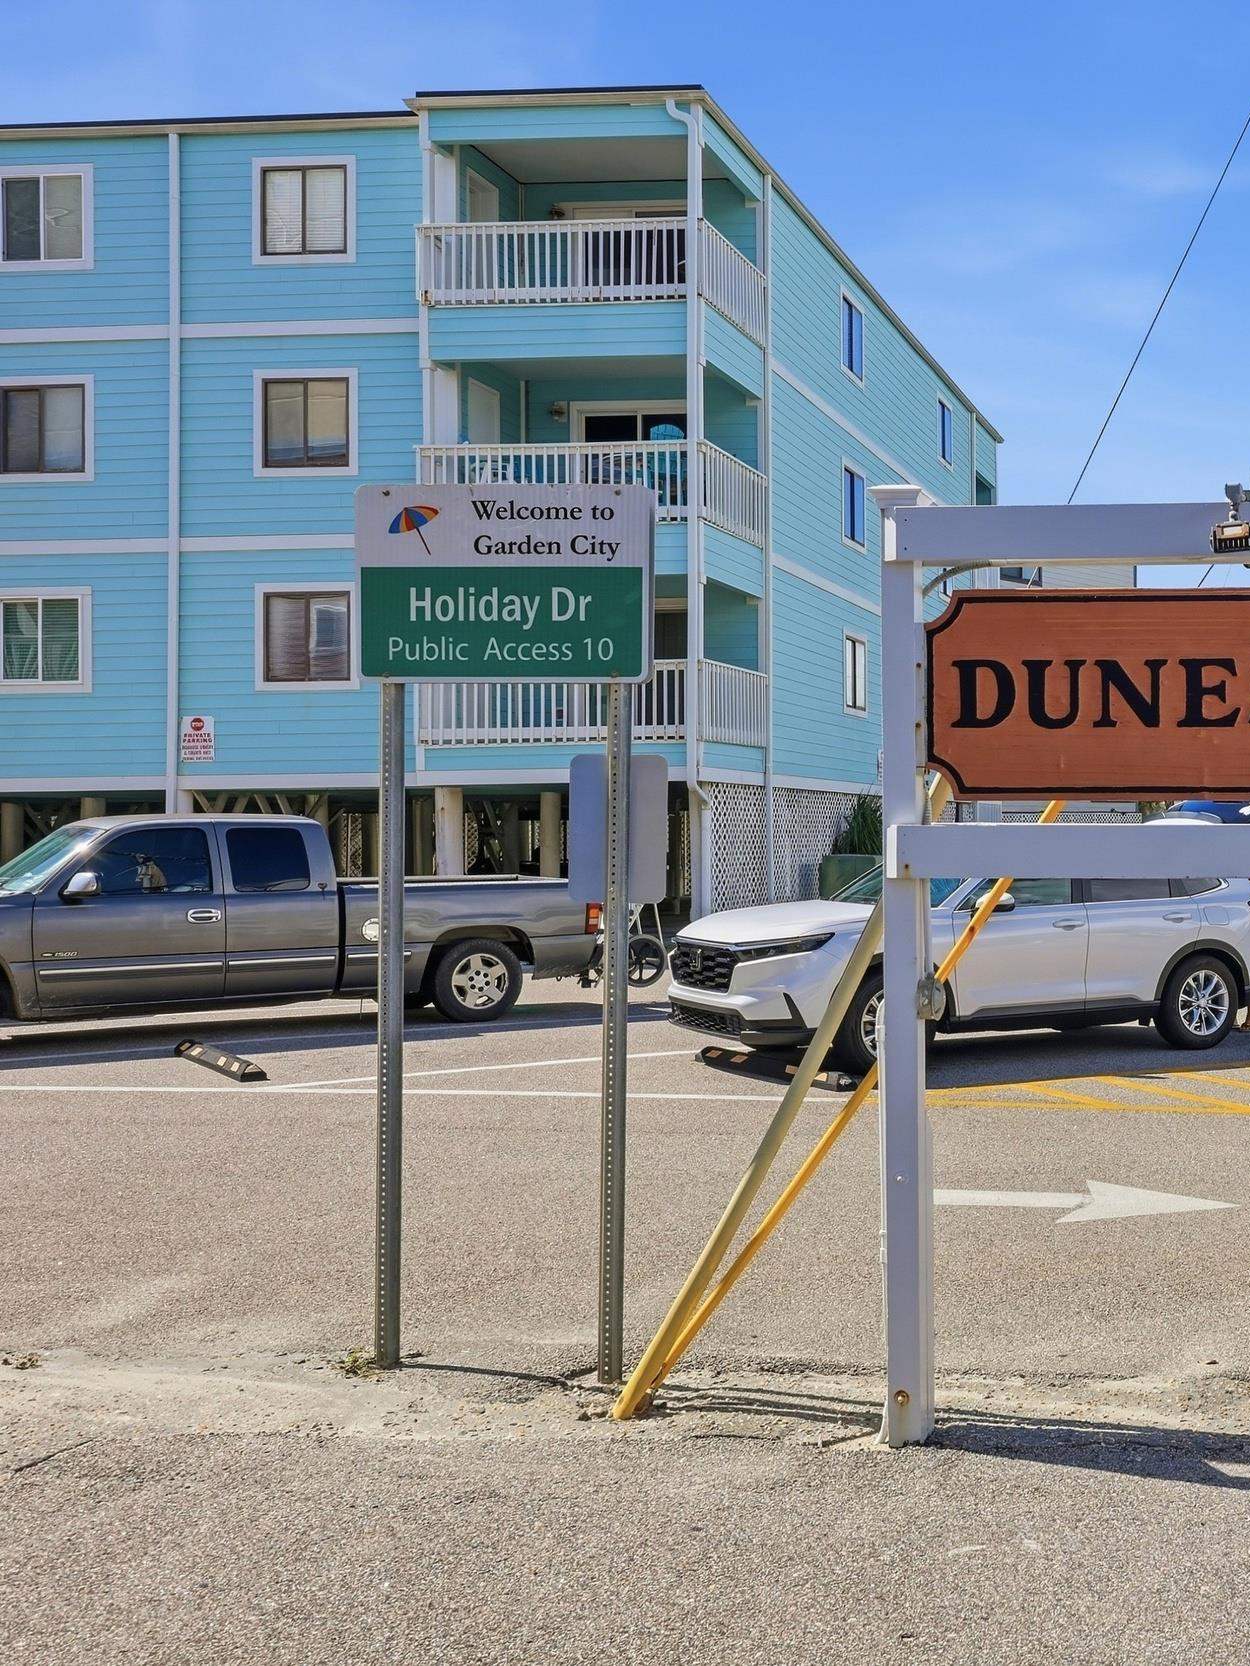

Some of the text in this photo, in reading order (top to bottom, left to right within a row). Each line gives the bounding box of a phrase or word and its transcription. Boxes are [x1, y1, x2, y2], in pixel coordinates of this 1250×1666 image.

[471, 500, 615, 521] Welcome to
[473, 534, 621, 562] Garden City
[409, 587, 592, 630] Holiday Dr
[388, 637, 614, 661] Public Access 10
